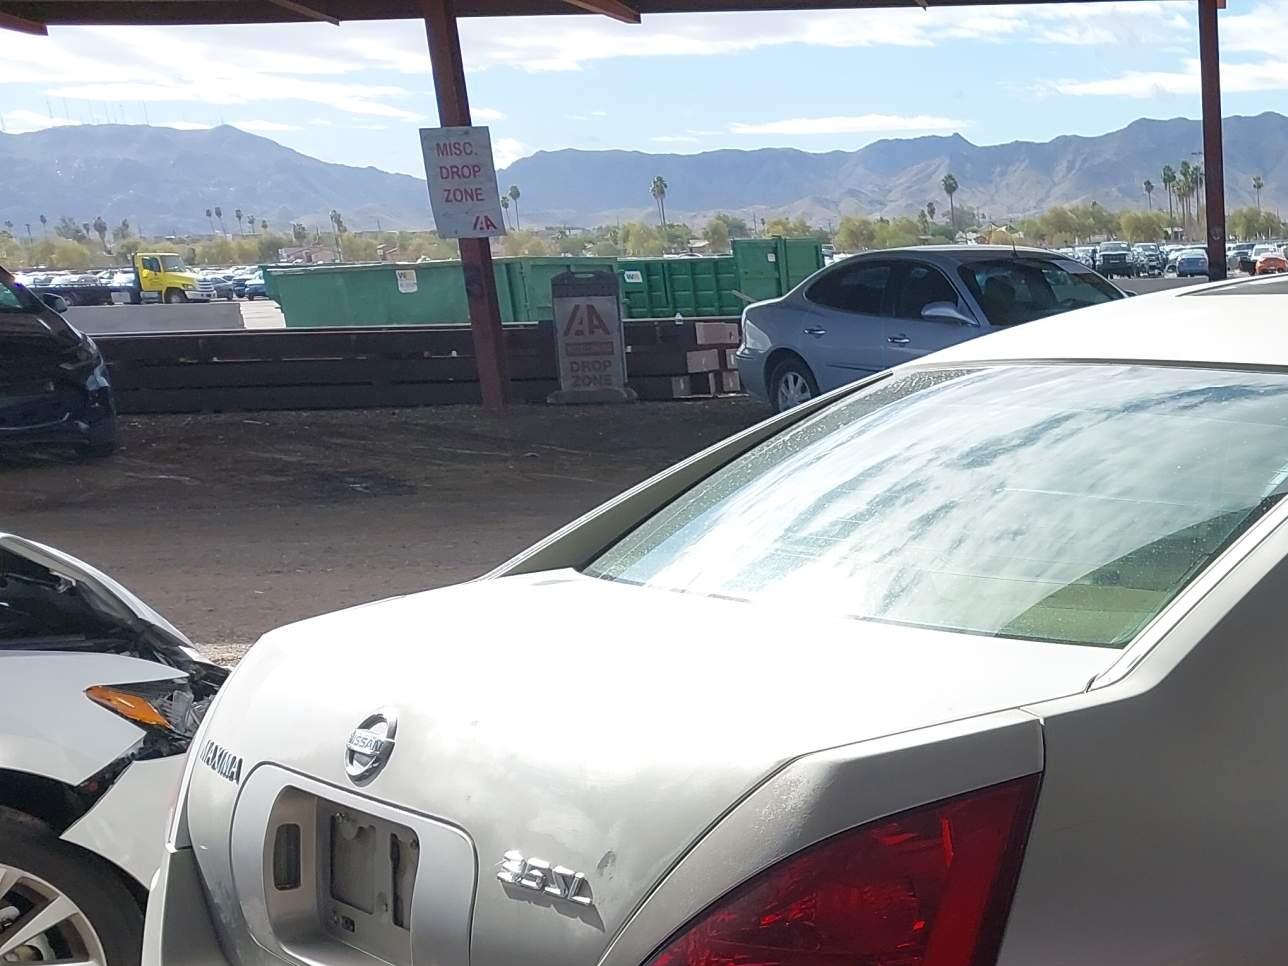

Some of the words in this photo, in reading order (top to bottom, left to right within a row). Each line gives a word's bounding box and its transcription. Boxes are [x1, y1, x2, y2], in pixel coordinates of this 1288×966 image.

[436, 141, 478, 157] MISC.
[440, 164, 481, 180] DROP
[443, 187, 486, 203] ZONE
[570, 360, 612, 373] DROP
[571, 374, 613, 388] ZONE
